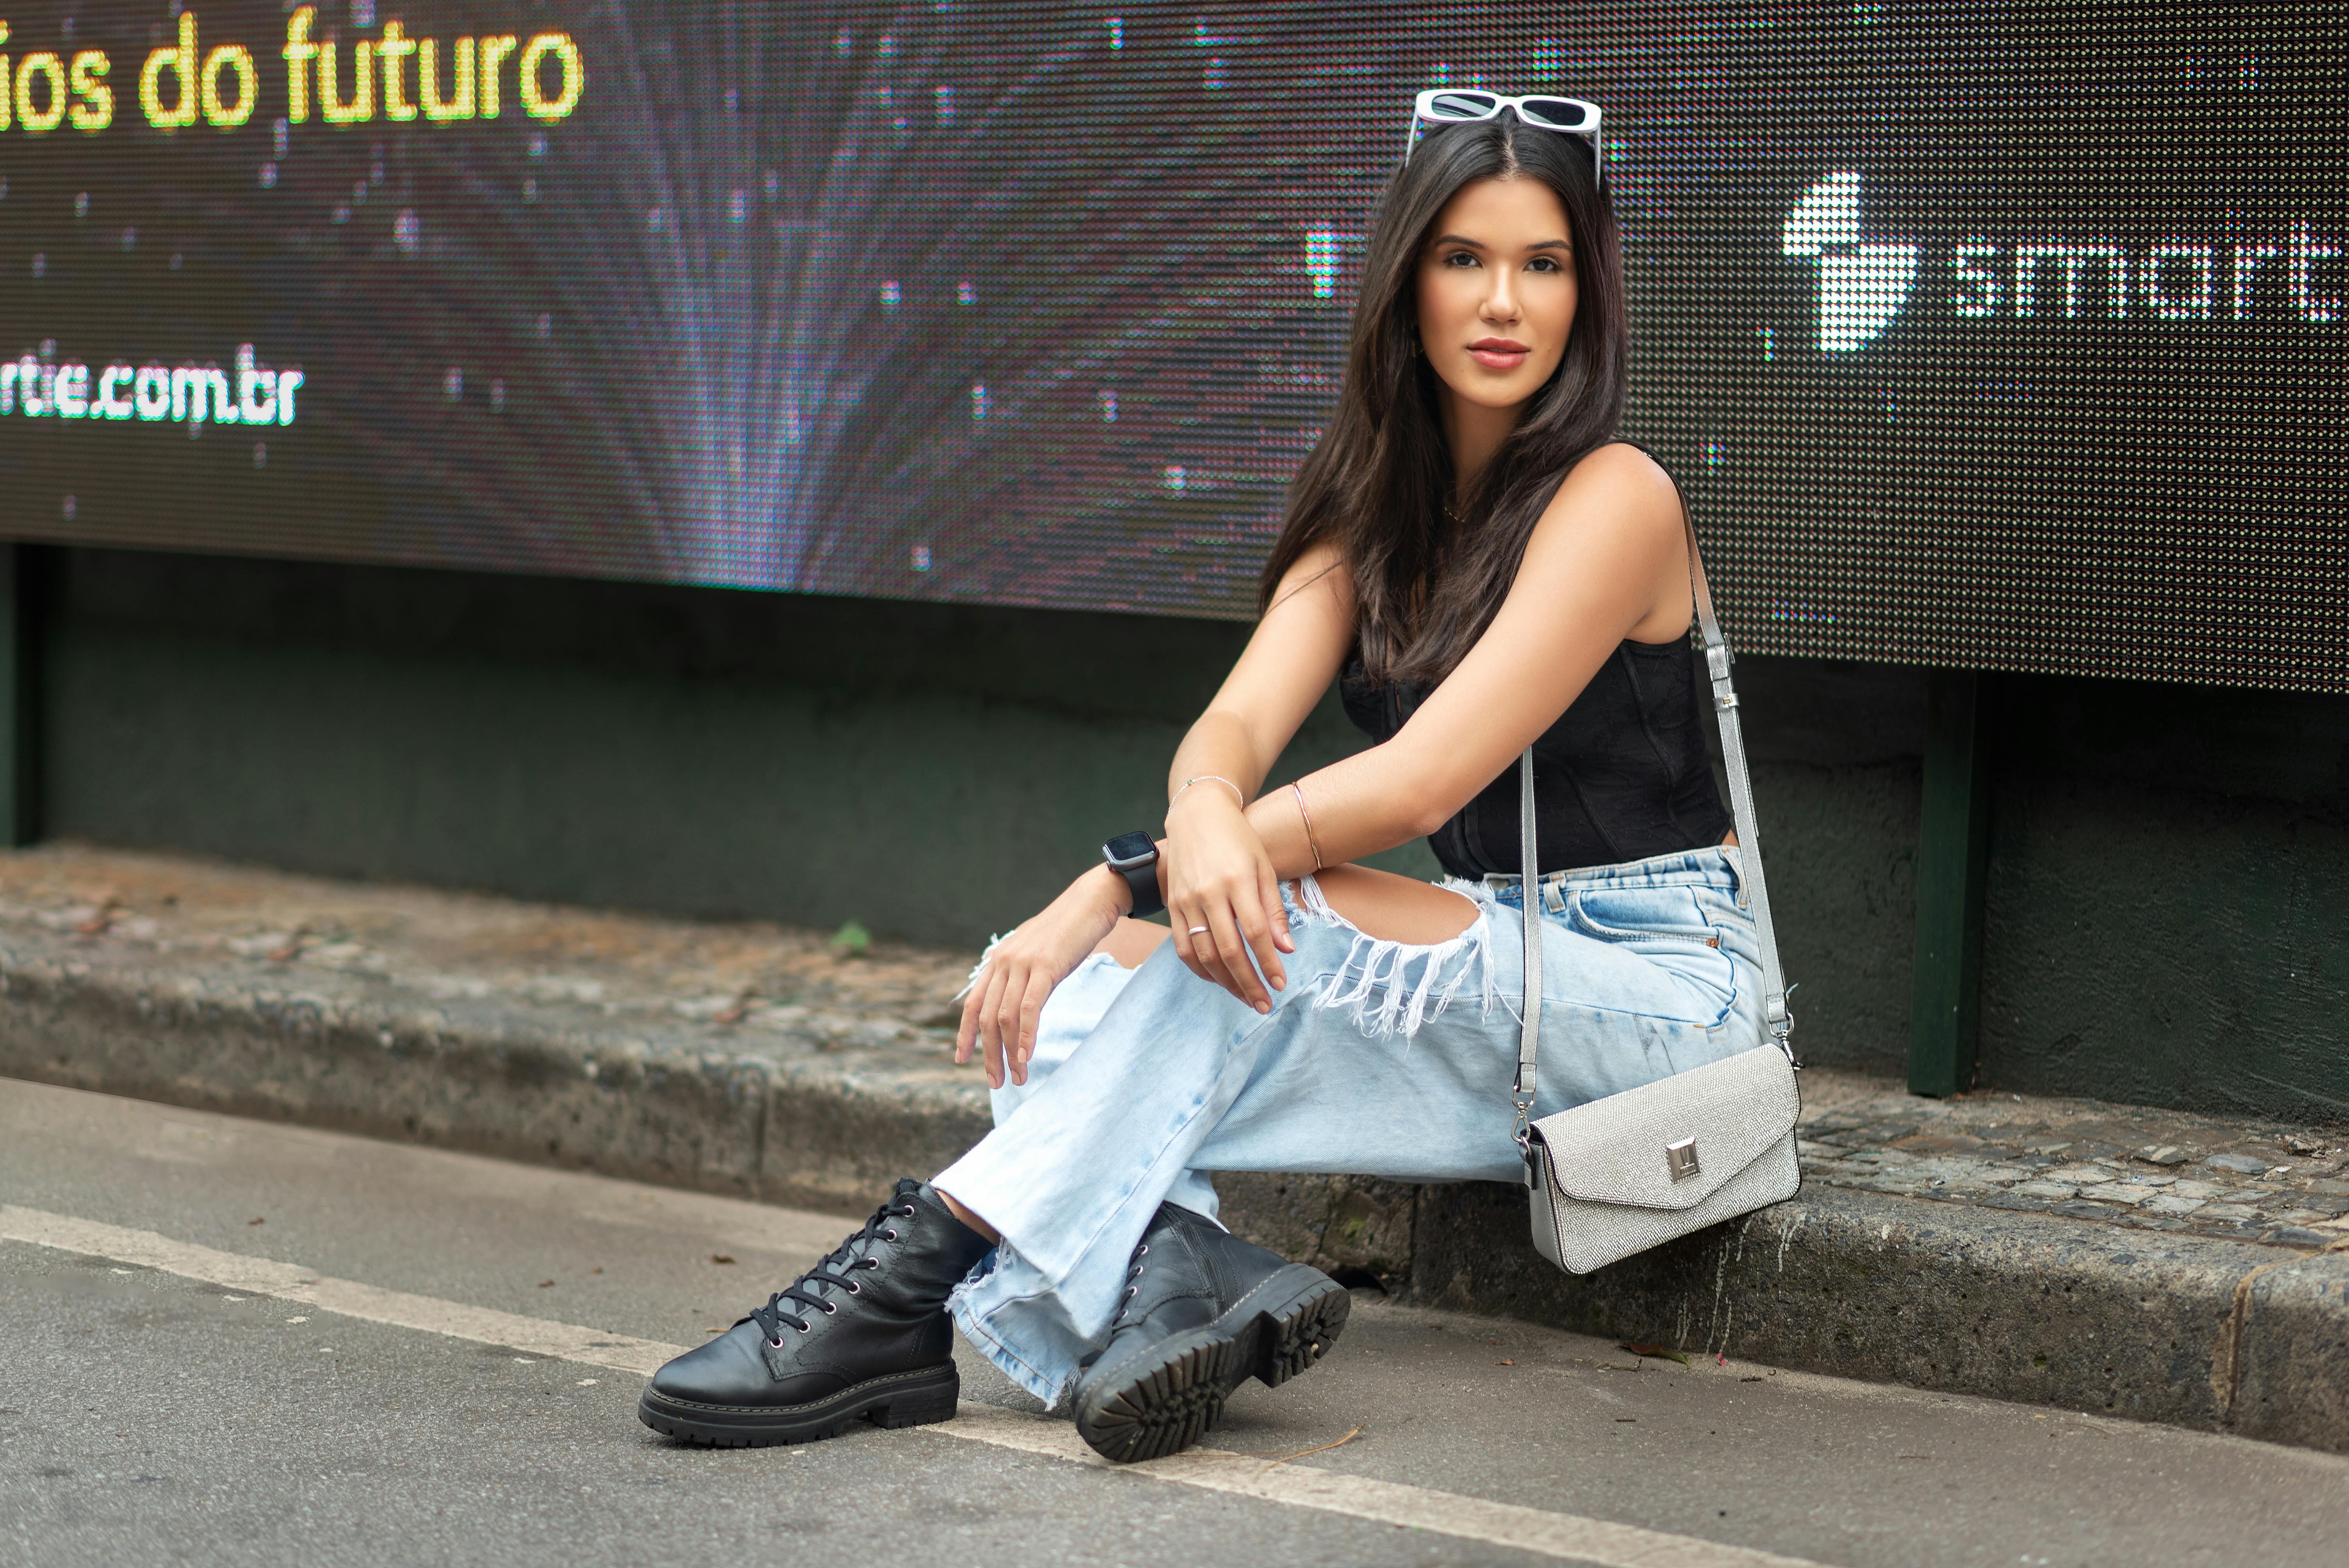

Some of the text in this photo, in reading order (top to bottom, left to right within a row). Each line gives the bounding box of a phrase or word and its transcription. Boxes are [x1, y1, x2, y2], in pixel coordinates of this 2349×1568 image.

[139, 11, 258, 127] do
[283, 6, 585, 123] futuro
[1952, 219, 2342, 323] smart
